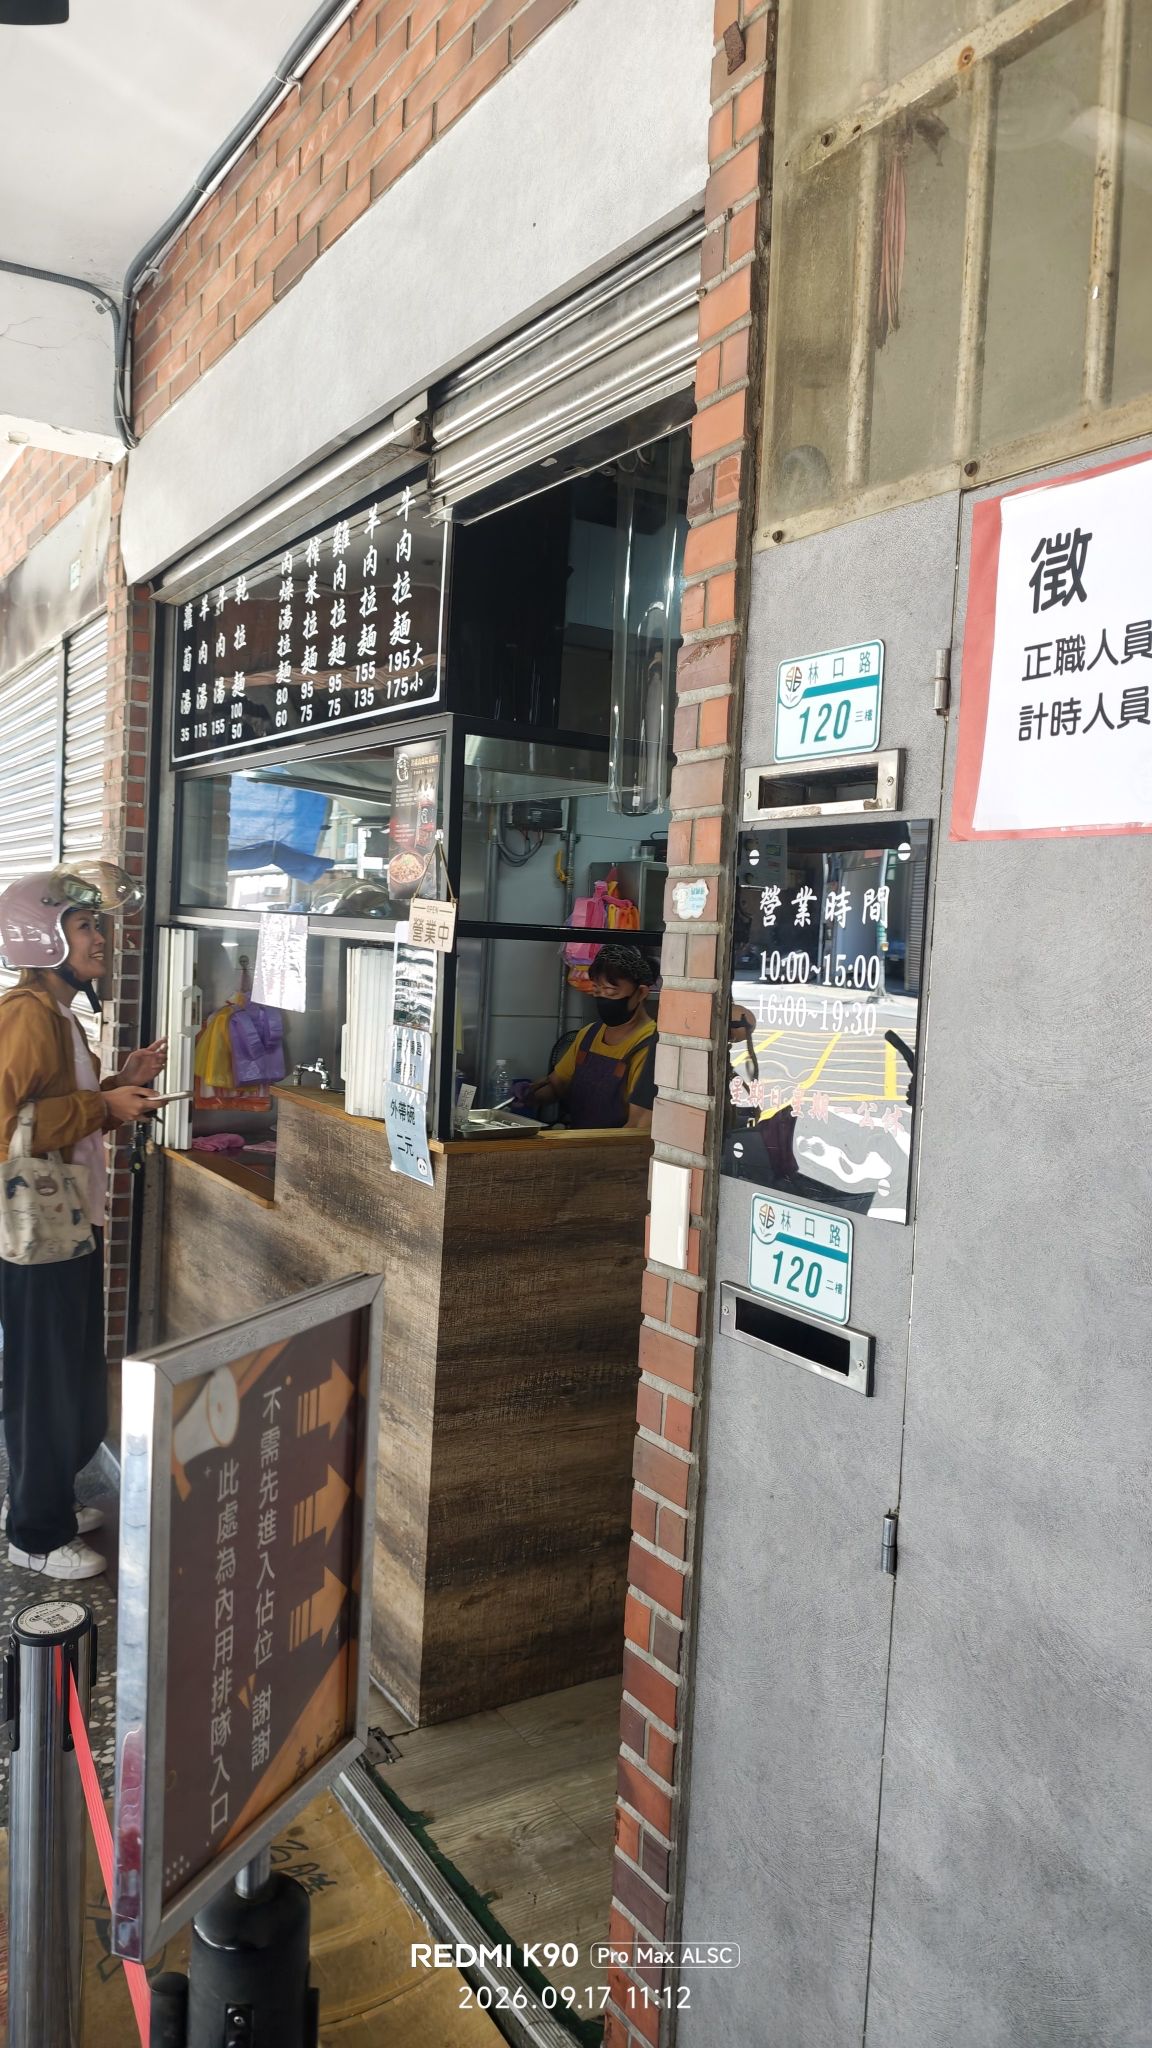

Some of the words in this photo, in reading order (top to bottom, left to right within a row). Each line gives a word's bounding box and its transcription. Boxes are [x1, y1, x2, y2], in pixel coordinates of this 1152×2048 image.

[356, 502, 381, 657] 羊肉拉麵
[389, 485, 416, 646] 牛肉拉麵
[1028, 527, 1093, 614] 徵
[300, 536, 322, 676] 榨菜拉麵
[328, 519, 351, 667] 雞肉拉麵
[275, 551, 294, 684] 肉燥湯拉麵
[196, 593, 210, 710] 羊肉湯
[213, 585, 228, 704] 牛肉湯
[231, 575, 249, 698] 乾拉麵
[1021, 619, 1152, 682] 正職人員
[355, 660, 376, 683] 155
[388, 642, 424, 673] 195大
[808, 650, 871, 685] 林口路
[276, 687, 288, 706] 80
[300, 680, 314, 700] 95
[328, 673, 342, 694] 95
[354, 686, 374, 709] 135
[386, 671, 423, 700] 175小
[230, 702, 243, 719] 100
[275, 709, 288, 728] 60
[300, 704, 313, 723] 75
[328, 697, 341, 718] 75
[798, 699, 852, 745] 120
[855, 708, 873, 723] 三樓
[1018, 685, 1151, 742] 計時人員
[180, 727, 190, 742] 35
[194, 722, 208, 739] 115
[211, 718, 226, 736] 155
[231, 722, 243, 739] 50
[426, 905, 438, 914] OPEN
[759, 884, 890, 929] 營業時間
[412, 917, 450, 947] 營業中
[758, 950, 880, 990] 10:00~15:00
[757, 993, 877, 1037] 16:00~19:30
[390, 1098, 416, 1126] 外帶碗
[396, 1133, 414, 1157] 二元
[780, 1209, 841, 1248] 林口路
[772, 1250, 823, 1298] 120
[825, 1279, 843, 1295] 二樓
[254, 1386, 282, 1669] 不需先進入佔位
[210, 1458, 240, 1835] 此處為內用排隊入口
[251, 1684, 272, 1772] 謝謝
